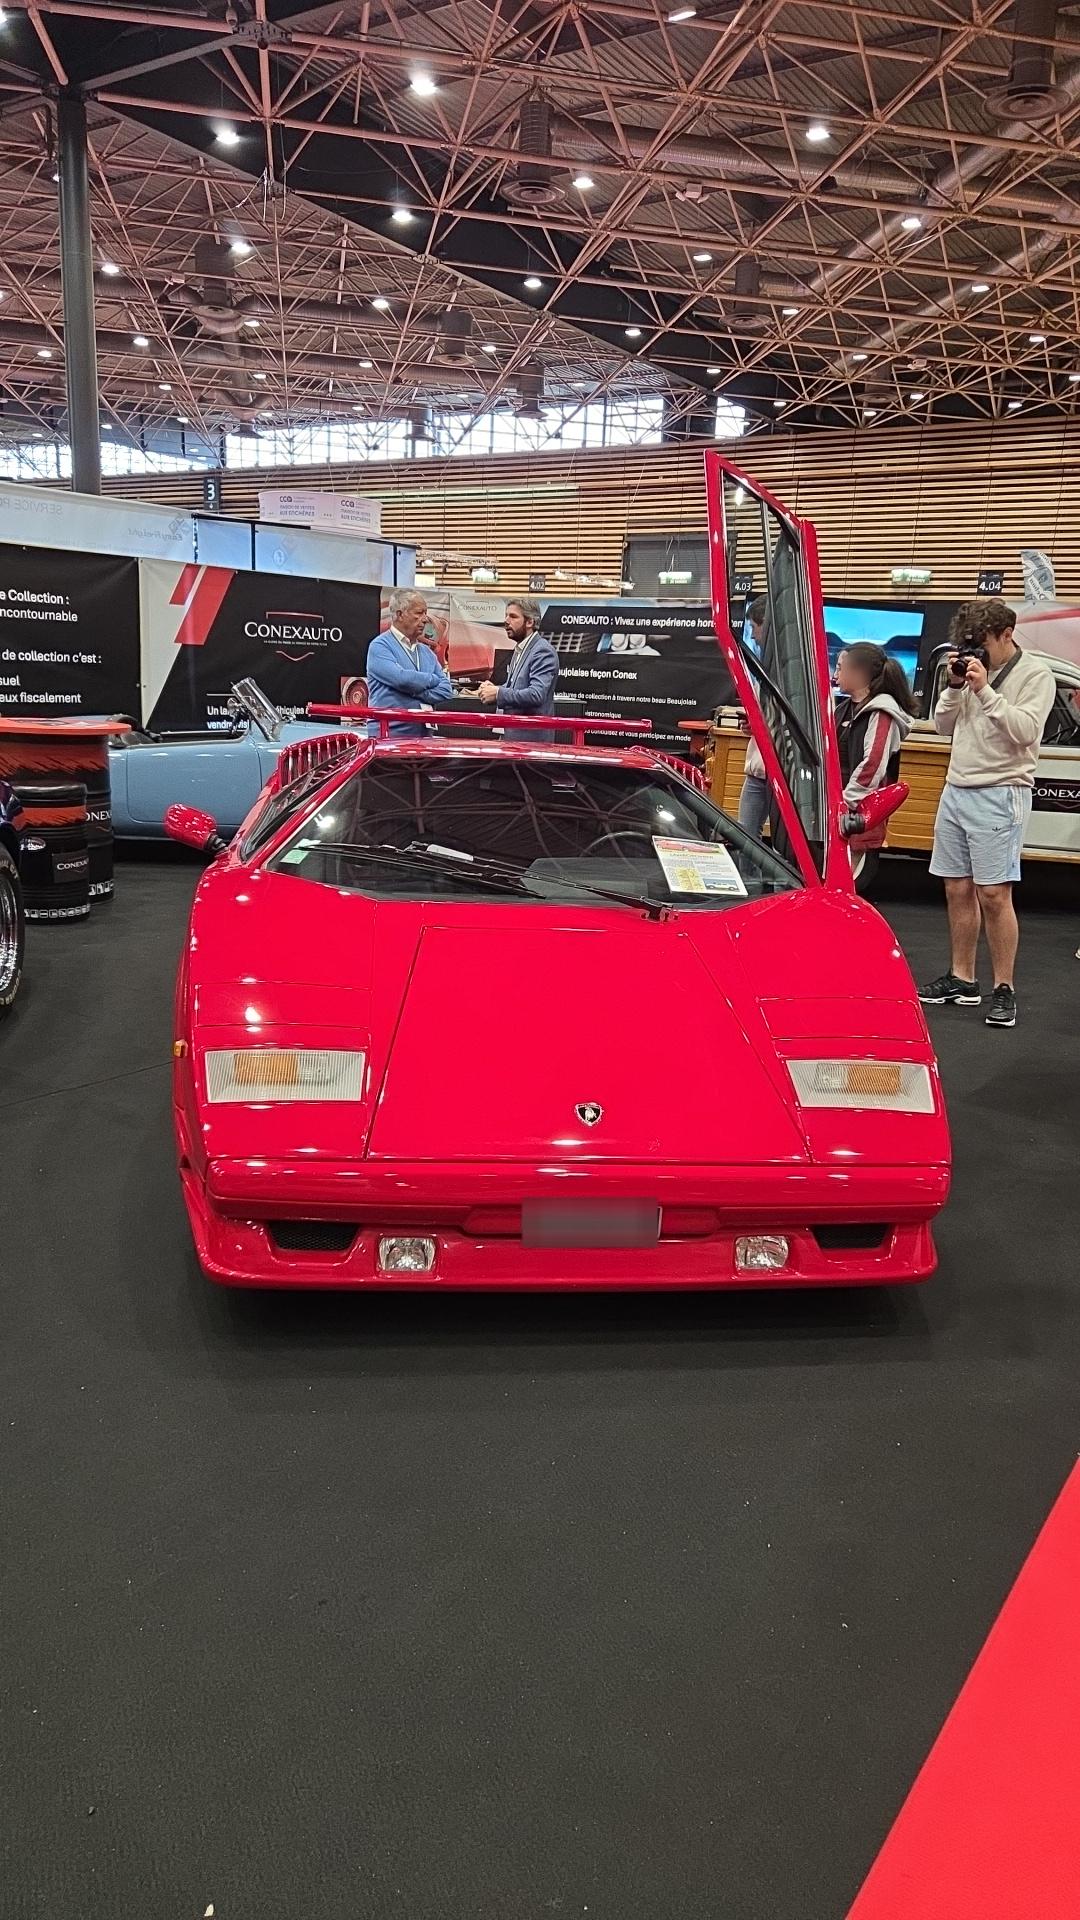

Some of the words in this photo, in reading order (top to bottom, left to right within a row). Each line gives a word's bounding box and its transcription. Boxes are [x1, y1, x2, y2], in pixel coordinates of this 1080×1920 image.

[207, 483, 215, 501] 3
[530, 582, 545, 591] 4.02
[734, 582, 751, 591] 4.03
[979, 581, 1002, 591] 4.04
[8, 589, 64, 605] Collection
[561, 615, 609, 625] CONEXAUTO
[614, 616, 635, 626] Vivez
[636, 618, 651, 626] une
[652, 617, 696, 629] expérience
[244, 621, 343, 642] CONEXAUTO
[2, 649, 16, 660] de
[18, 650, 70, 663] collection
[590, 668, 612, 680] façon
[612, 669, 638, 680] Conex
[20, 691, 82, 704] fiscalement
[585, 693, 612, 701] collection
[617, 695, 635, 703] travers
[666, 697, 697, 706] Beaujolais
[206, 705, 219, 715] Un
[625, 731, 638, 739] vous
[638, 731, 667, 741] participez
[674, 734, 692, 742] mode
